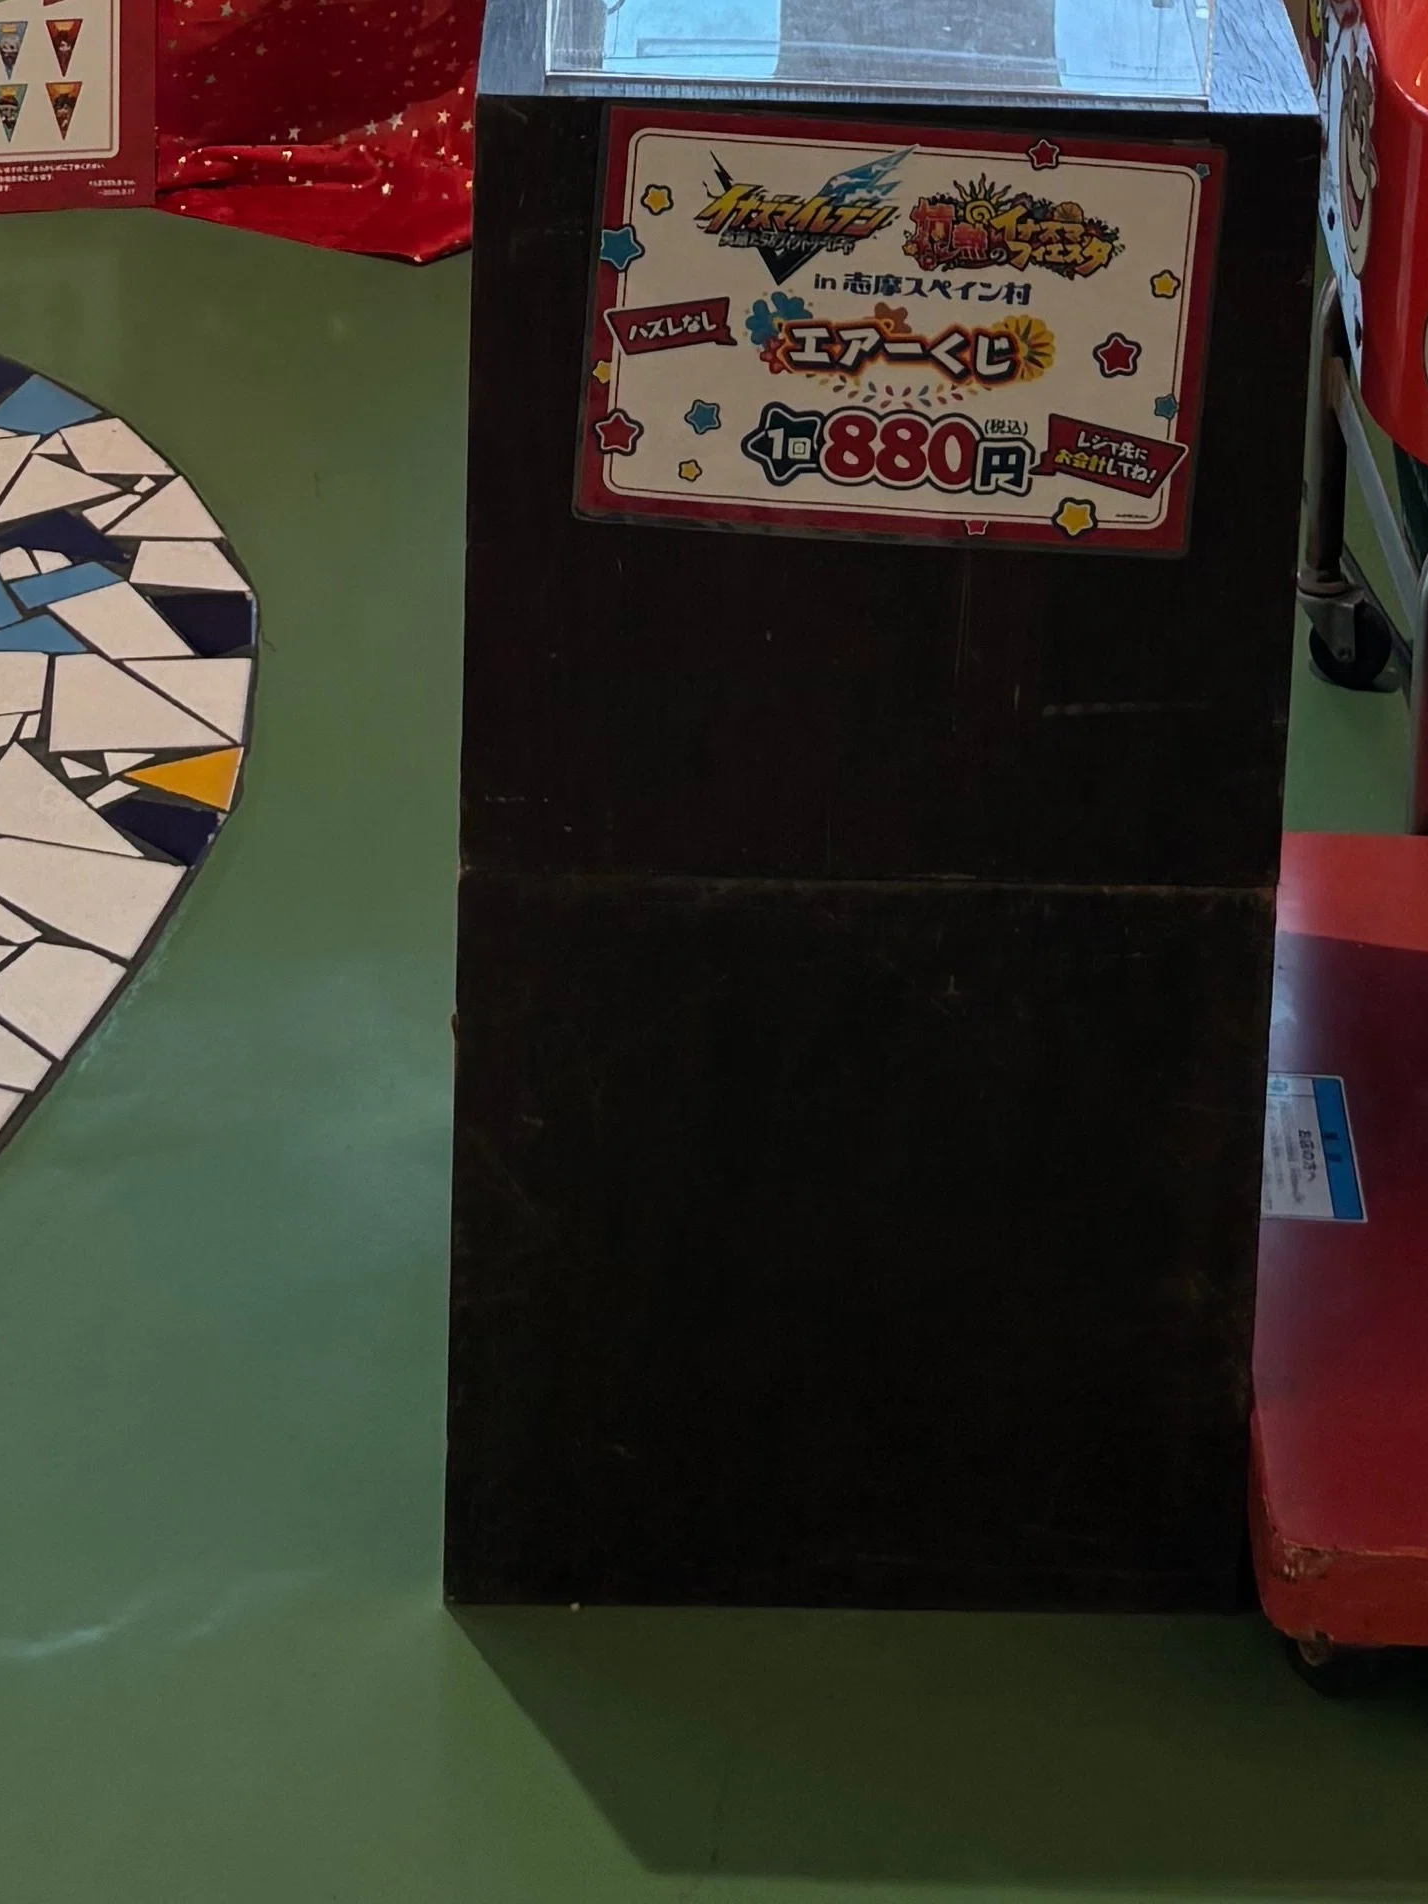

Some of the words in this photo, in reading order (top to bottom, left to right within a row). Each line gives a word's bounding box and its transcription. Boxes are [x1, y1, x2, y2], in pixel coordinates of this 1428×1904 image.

[694, 184, 901, 236] イナズマイレブン
[815, 272, 838, 290] in
[843, 271, 1033, 306] 志摩スペイン村
[628, 310, 719, 341] ハズレなし
[791, 323, 1021, 383] エアーくじ
